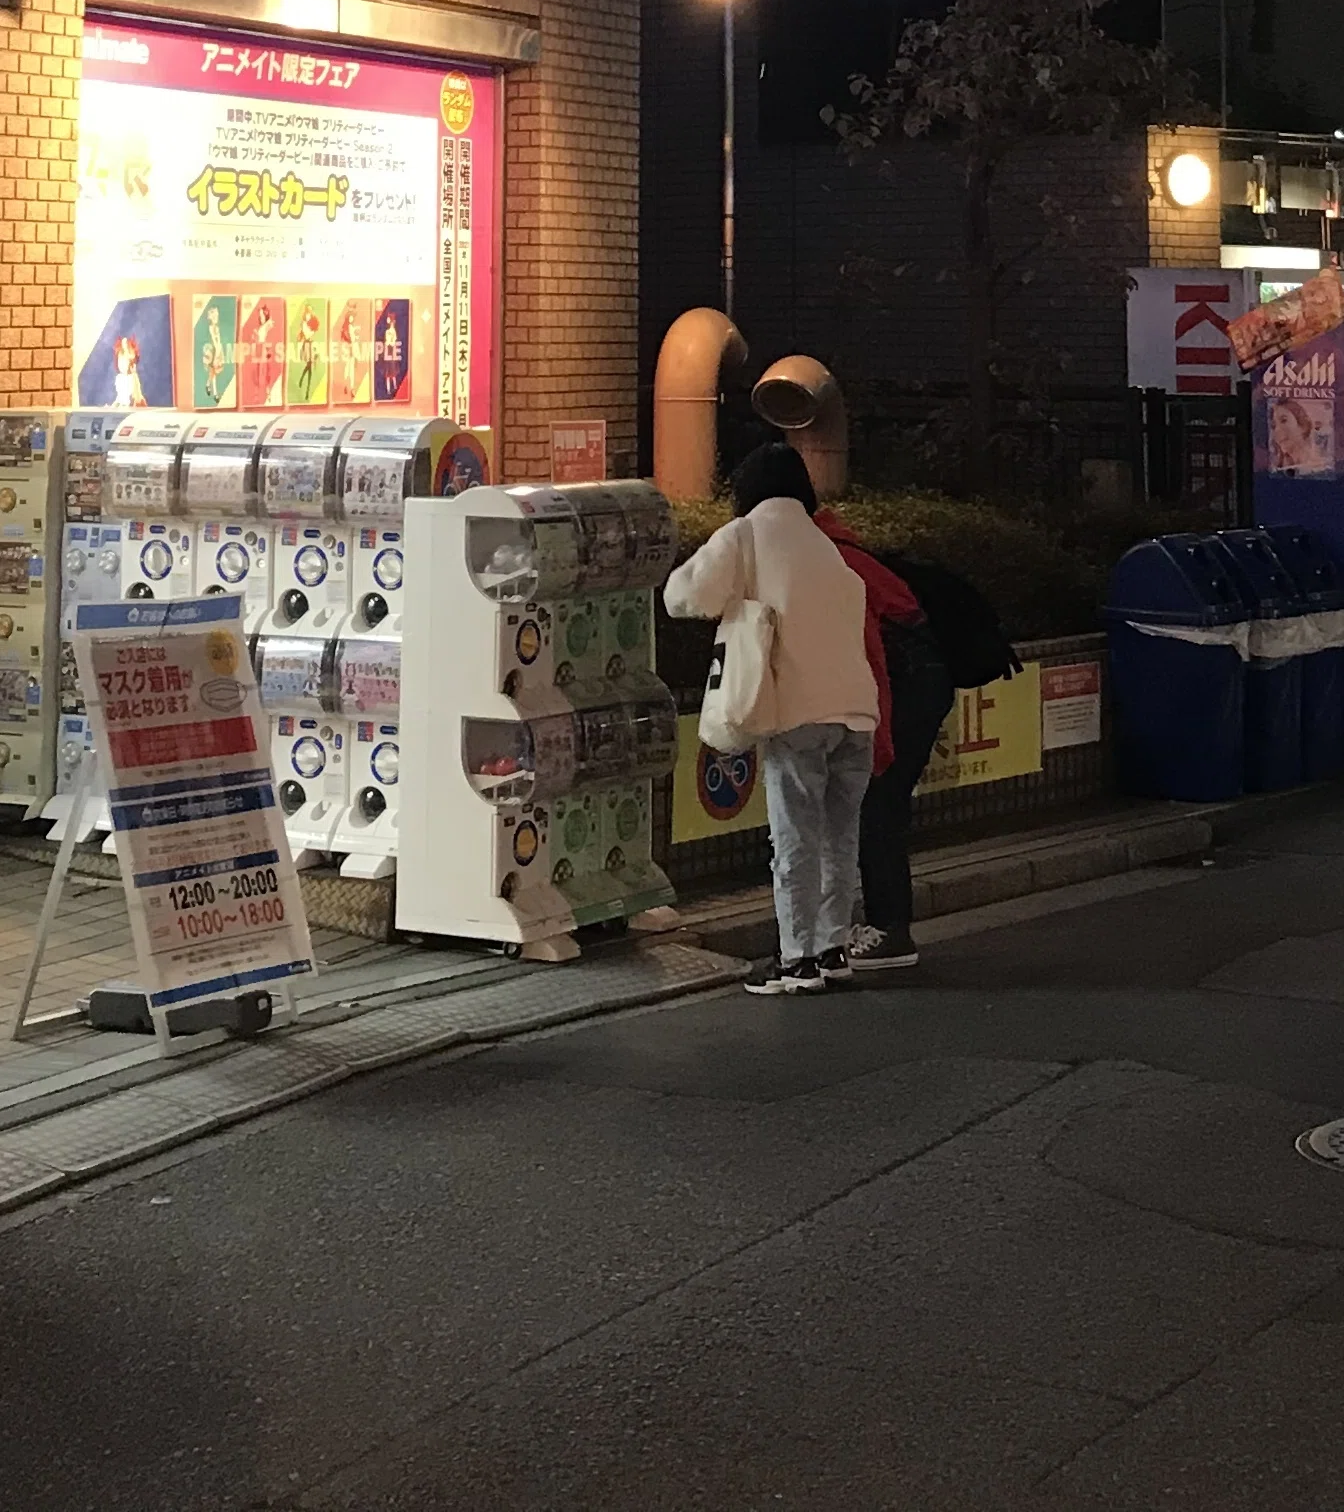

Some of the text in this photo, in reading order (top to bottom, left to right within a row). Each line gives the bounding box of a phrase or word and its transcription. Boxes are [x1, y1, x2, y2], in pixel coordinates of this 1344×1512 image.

[200, 42, 361, 90] アニメイト限定フェア
[187, 163, 350, 223] イラストカード
[442, 139, 455, 230] 開催場所
[459, 140, 472, 231] 開催期間
[1263, 352, 1336, 387] Asahi
[1263, 386, 1336, 400] SOFT DRINKS
[115, 646, 167, 663] ご入店には
[98, 666, 194, 696] マスク着用が
